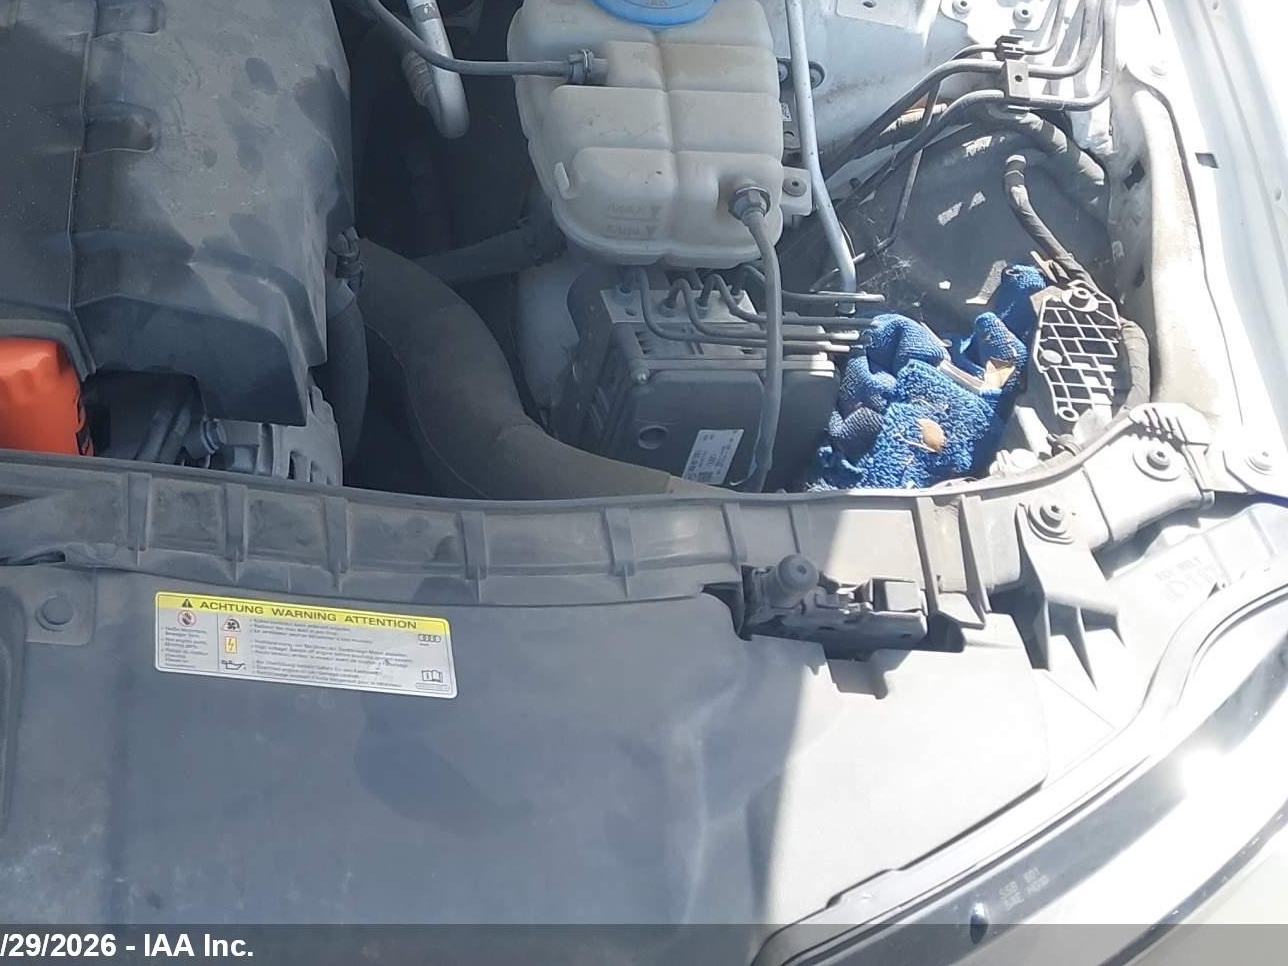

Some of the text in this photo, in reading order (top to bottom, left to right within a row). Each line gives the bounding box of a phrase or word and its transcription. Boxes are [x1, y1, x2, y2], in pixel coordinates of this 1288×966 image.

[199, 600, 417, 629] ACHTUNG WARNING ATTENTION
